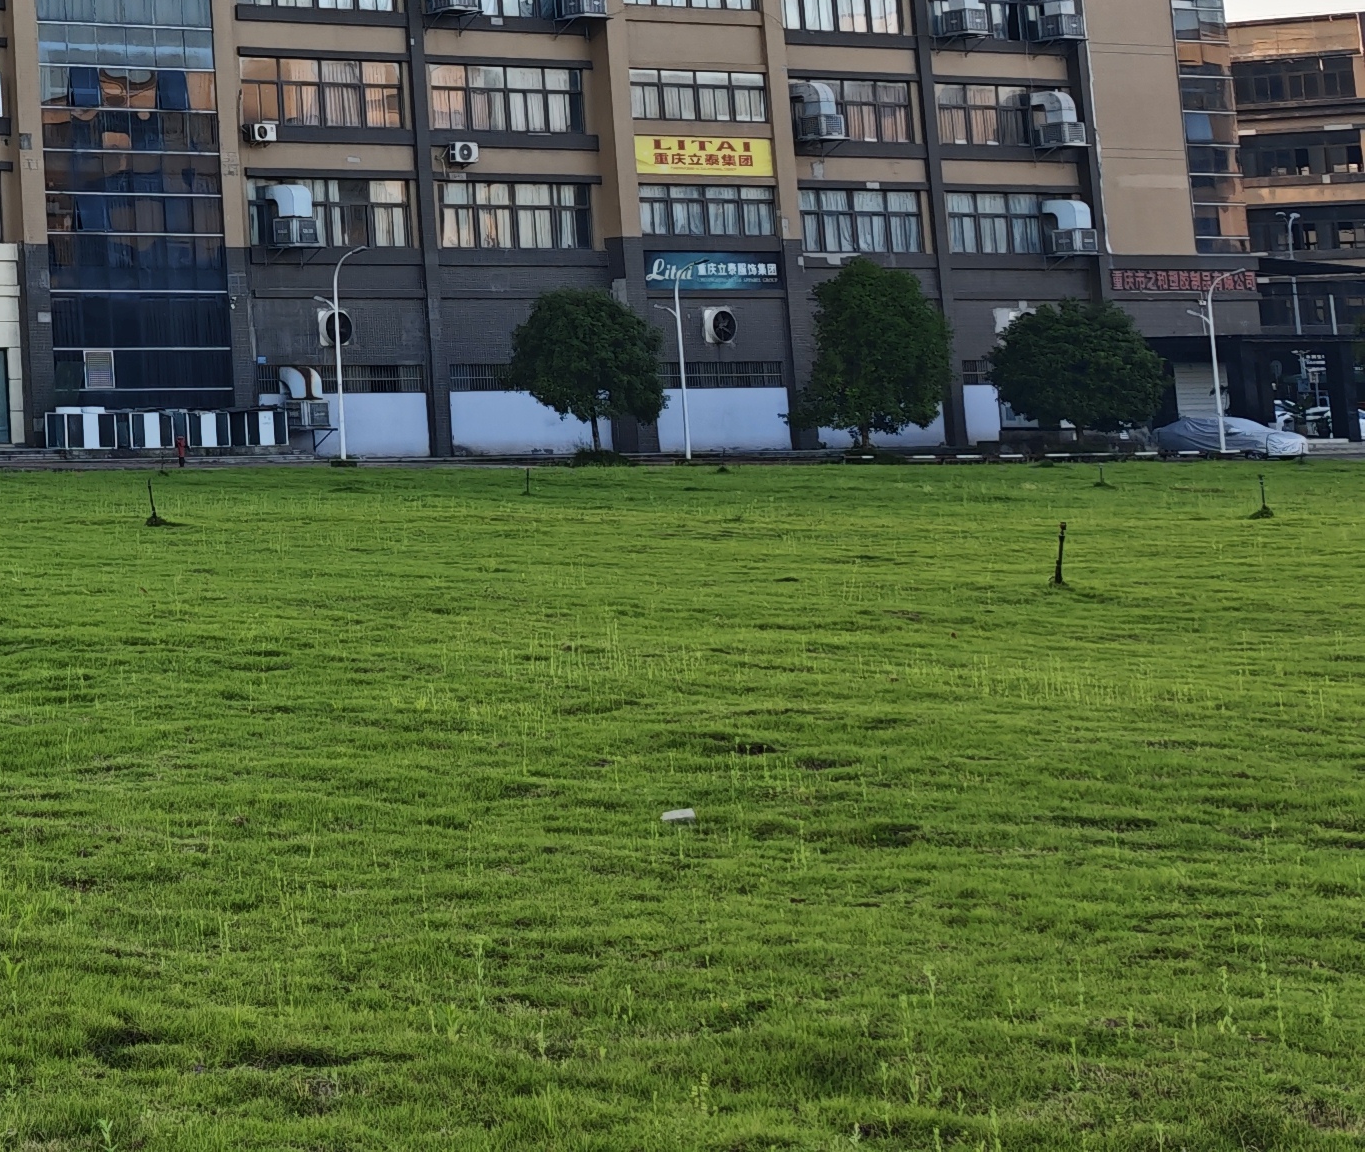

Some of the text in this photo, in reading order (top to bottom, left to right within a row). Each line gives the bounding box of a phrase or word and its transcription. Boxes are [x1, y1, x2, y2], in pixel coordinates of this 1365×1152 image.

[653, 139, 751, 152] LITAI
[653, 153, 753, 166] 重庆立泰集团
[697, 263, 777, 276] 重庆立泰服饰集团
